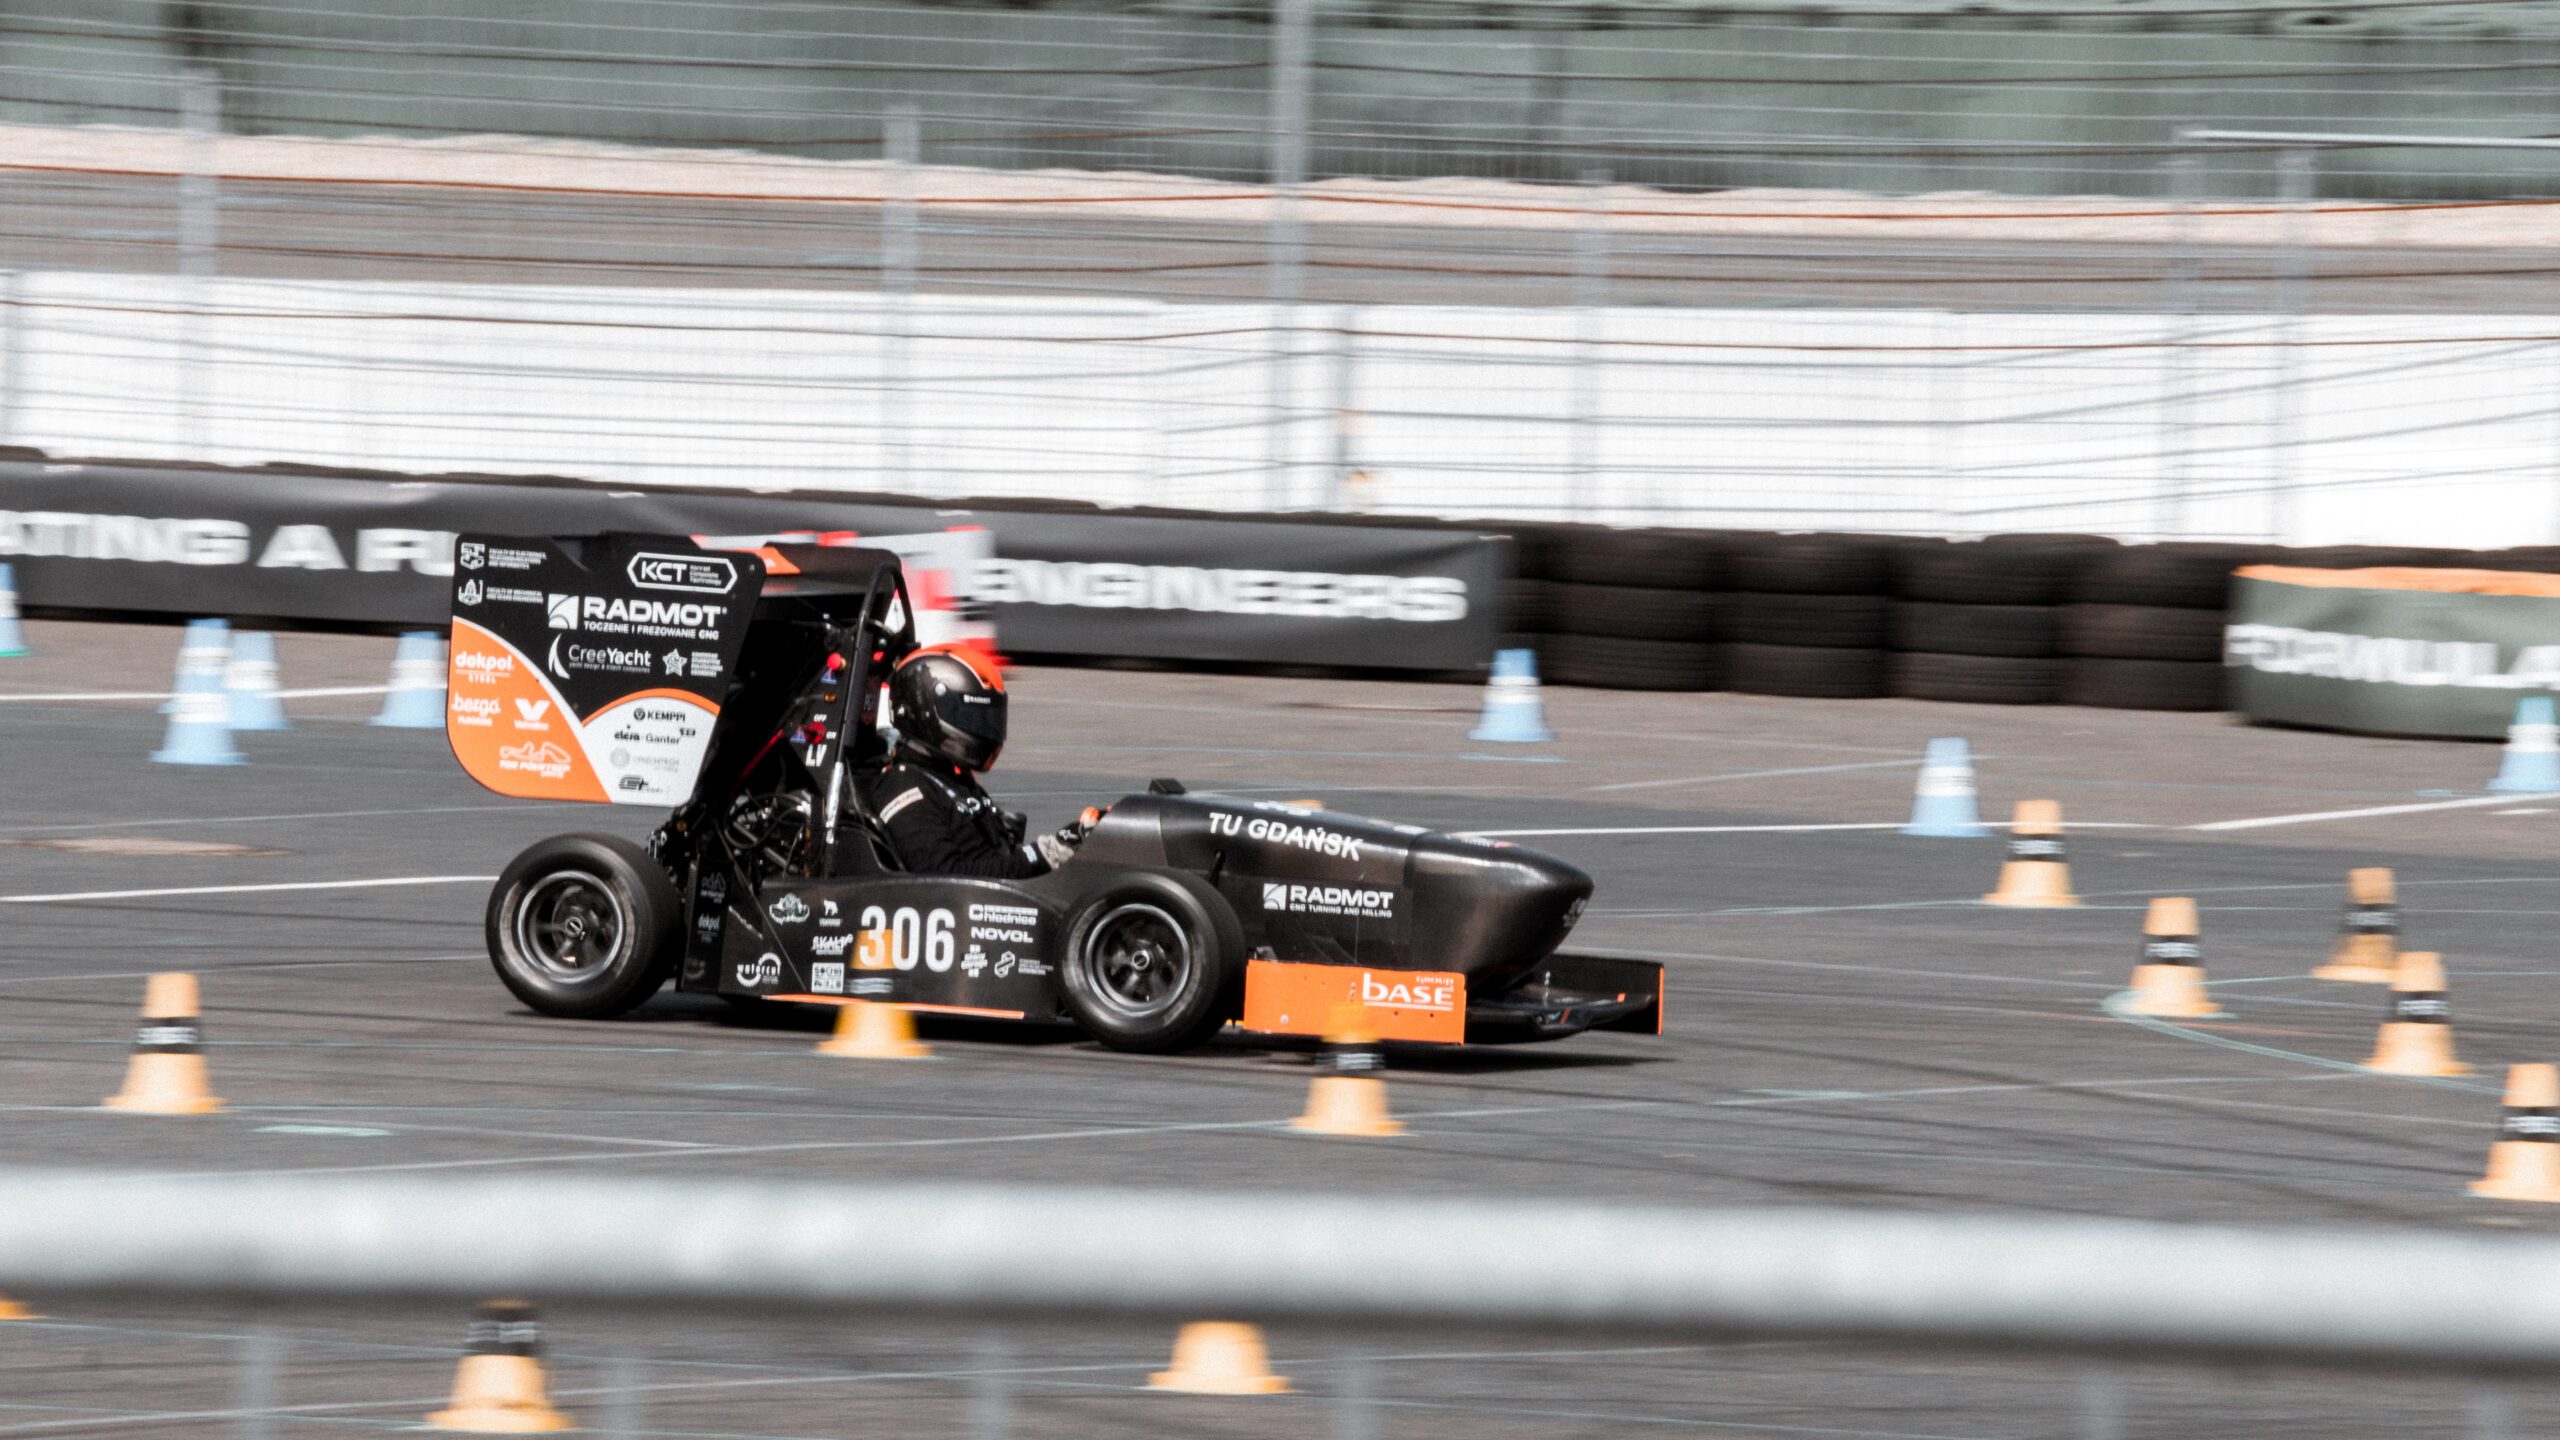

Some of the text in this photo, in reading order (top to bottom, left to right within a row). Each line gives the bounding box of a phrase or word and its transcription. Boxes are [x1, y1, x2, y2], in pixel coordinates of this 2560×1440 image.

[255, 524, 350, 570] A
[641, 560, 687, 582] KCT
[970, 557, 1468, 622] ENGINEERS
[583, 596, 721, 628] RADMOT
[584, 620, 629, 633] TOCZENIE
[631, 624, 635, 634] I
[637, 625, 696, 639] FREZOWANIE
[455, 650, 512, 672] dekpol
[568, 644, 651, 667] CreeYacht
[647, 710, 686, 722] KEMPPI
[805, 744, 828, 767] LV
[1209, 812, 1364, 862] TU GDAŃSK
[1290, 885, 1394, 908] RADMOT
[1308, 904, 1342, 915] TURNING
[1344, 906, 1360, 916] AND
[1362, 908, 1393, 918] MILLING
[859, 905, 955, 973] 306
[970, 926, 1034, 944] NOVOL
